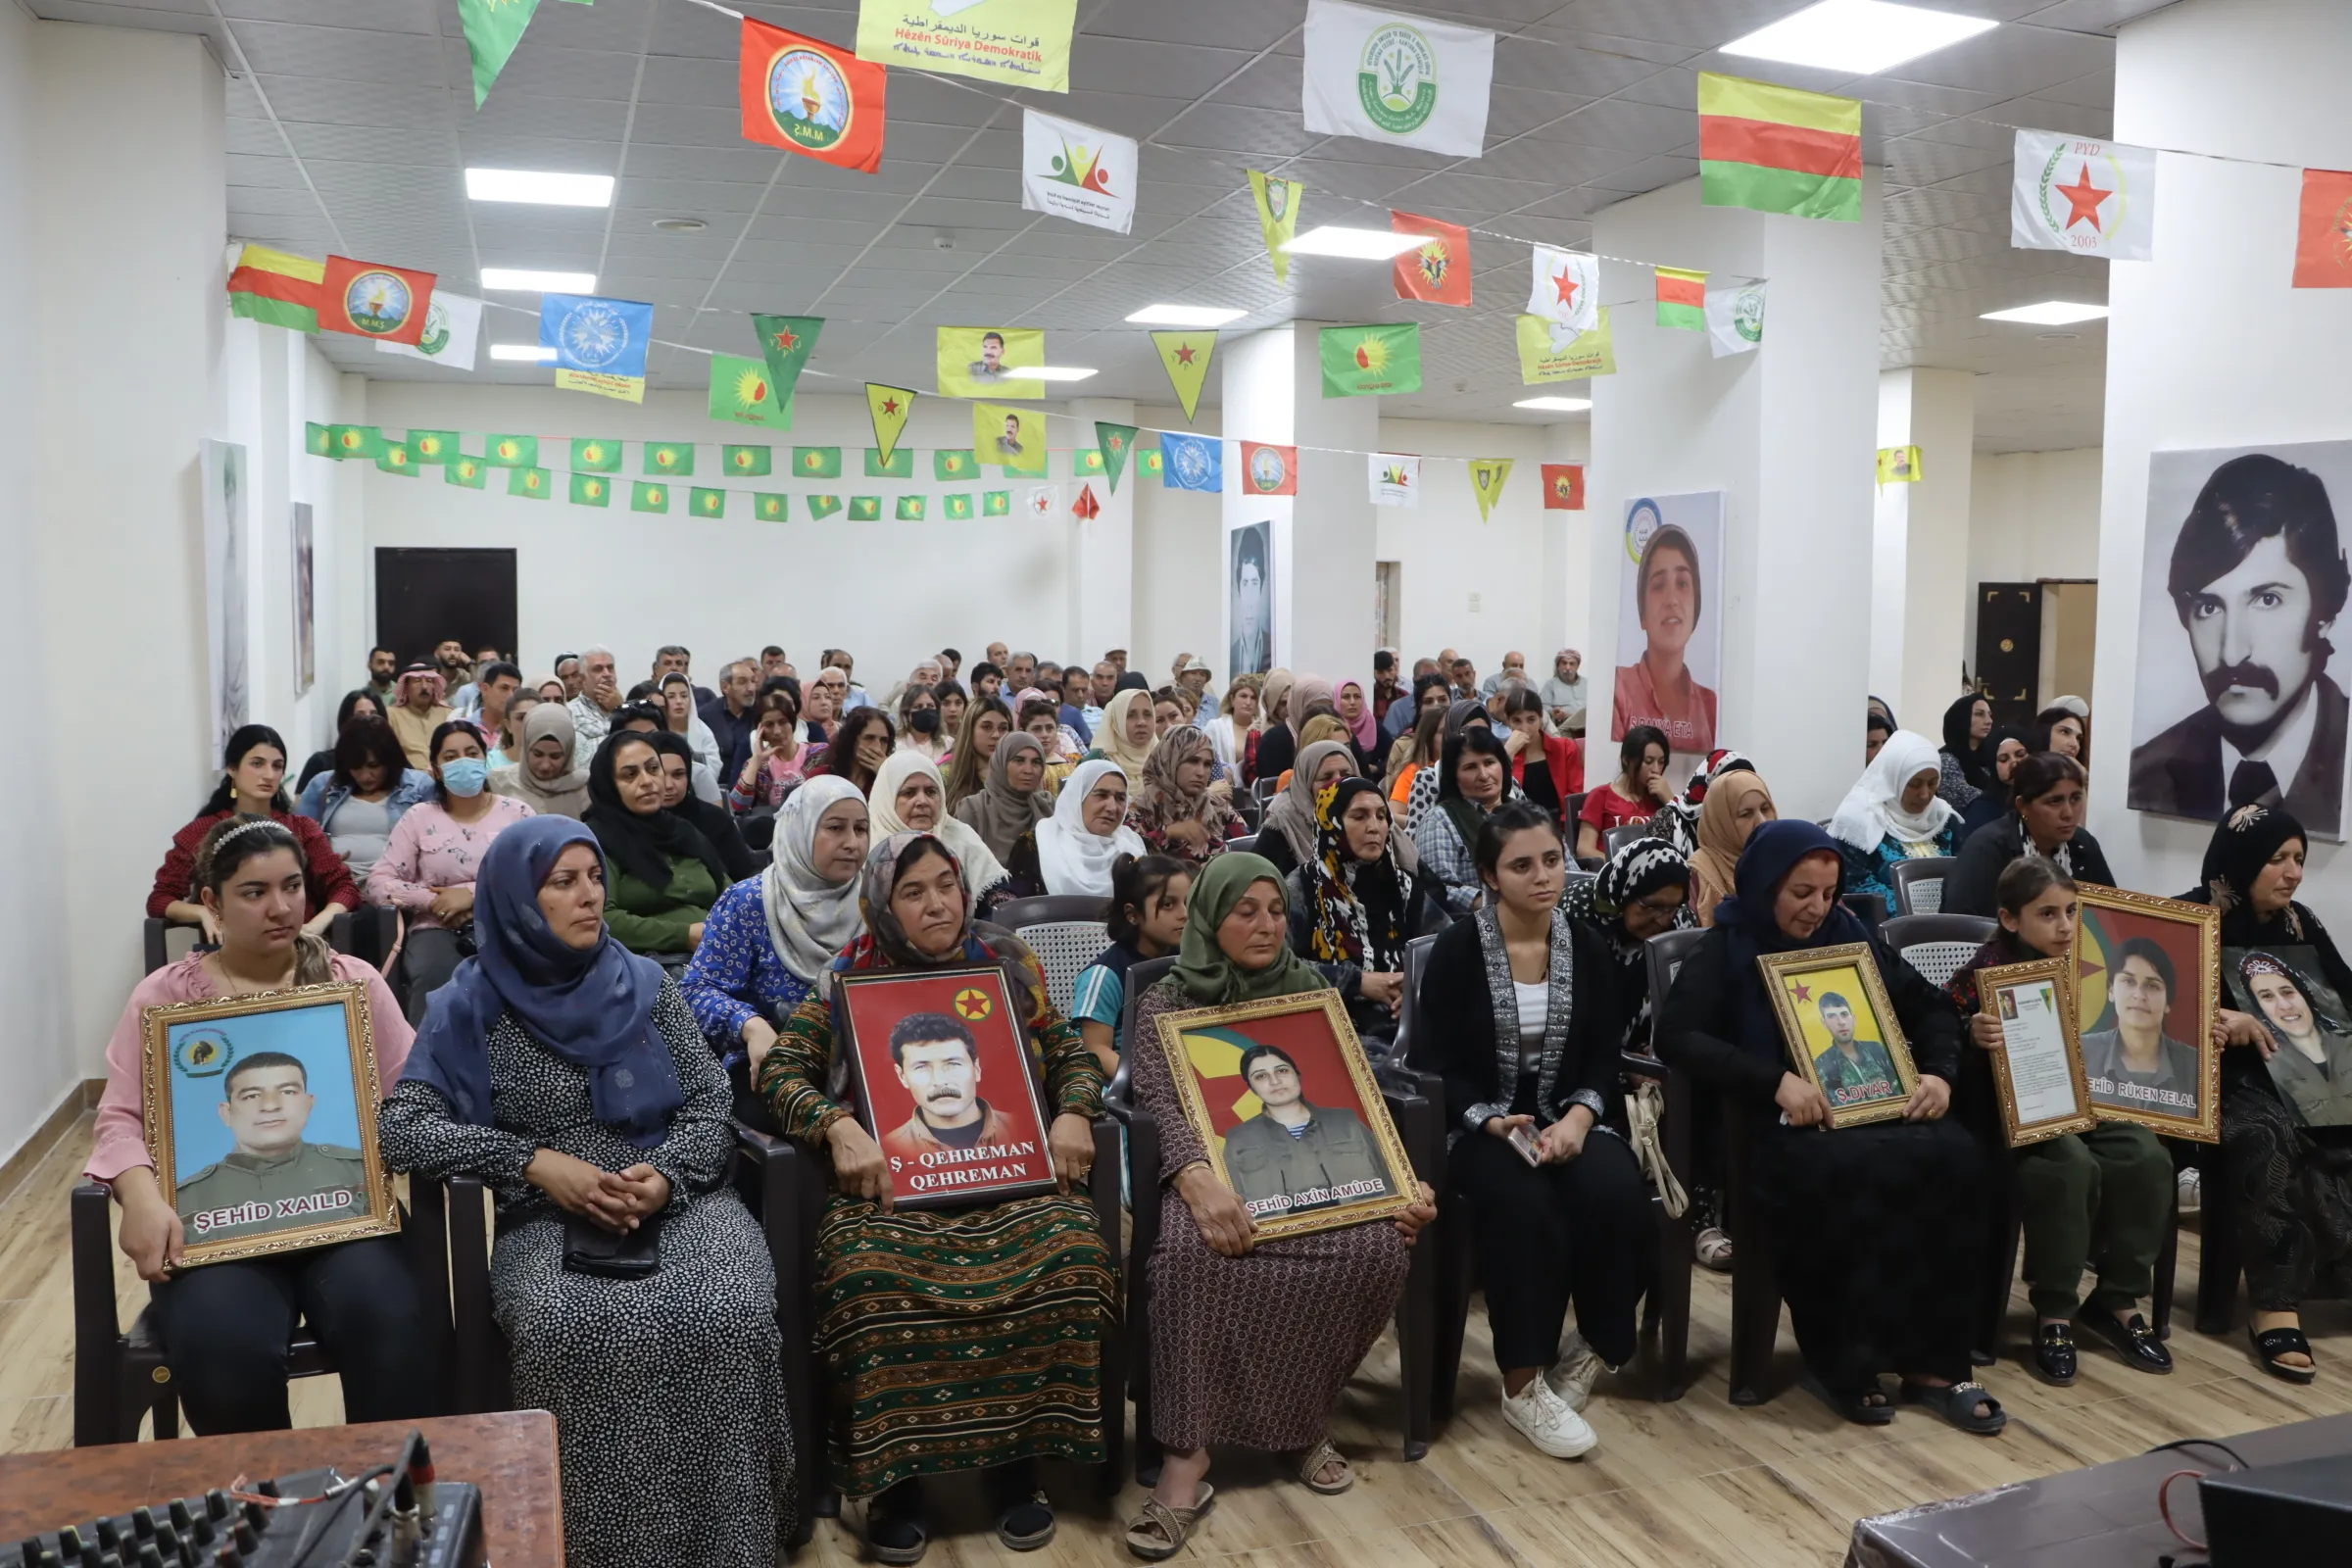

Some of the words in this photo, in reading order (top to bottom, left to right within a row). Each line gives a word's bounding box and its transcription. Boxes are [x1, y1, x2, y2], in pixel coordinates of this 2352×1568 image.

[902, 14, 967, 34] الديمقراطية
[895, 27, 932, 44] Hêzên
[934, 33, 971, 50] Sûriya
[971, 25, 1006, 45] سوريا
[1009, 34, 1040, 49] قوات
[2074, 142, 2100, 157] PYD
[2071, 234, 2097, 248] 2003
[1673, 720, 1693, 739] ETA
[2086, 1075, 2115, 1096] EHÎD
[2158, 1088, 2197, 1109] ZELAL
[890, 1155, 903, 1173] Ş
[918, 1141, 1037, 1168] QEHREMAN
[909, 1162, 1027, 1191] QEHREMAN
[1247, 1192, 1293, 1216] ŞEHÎD
[1294, 1188, 1332, 1208] AXÎN
[1331, 1178, 1386, 1200] AMÛDE
[194, 1202, 271, 1234] ŞEHÎD
[277, 1190, 353, 1218] XAILD
